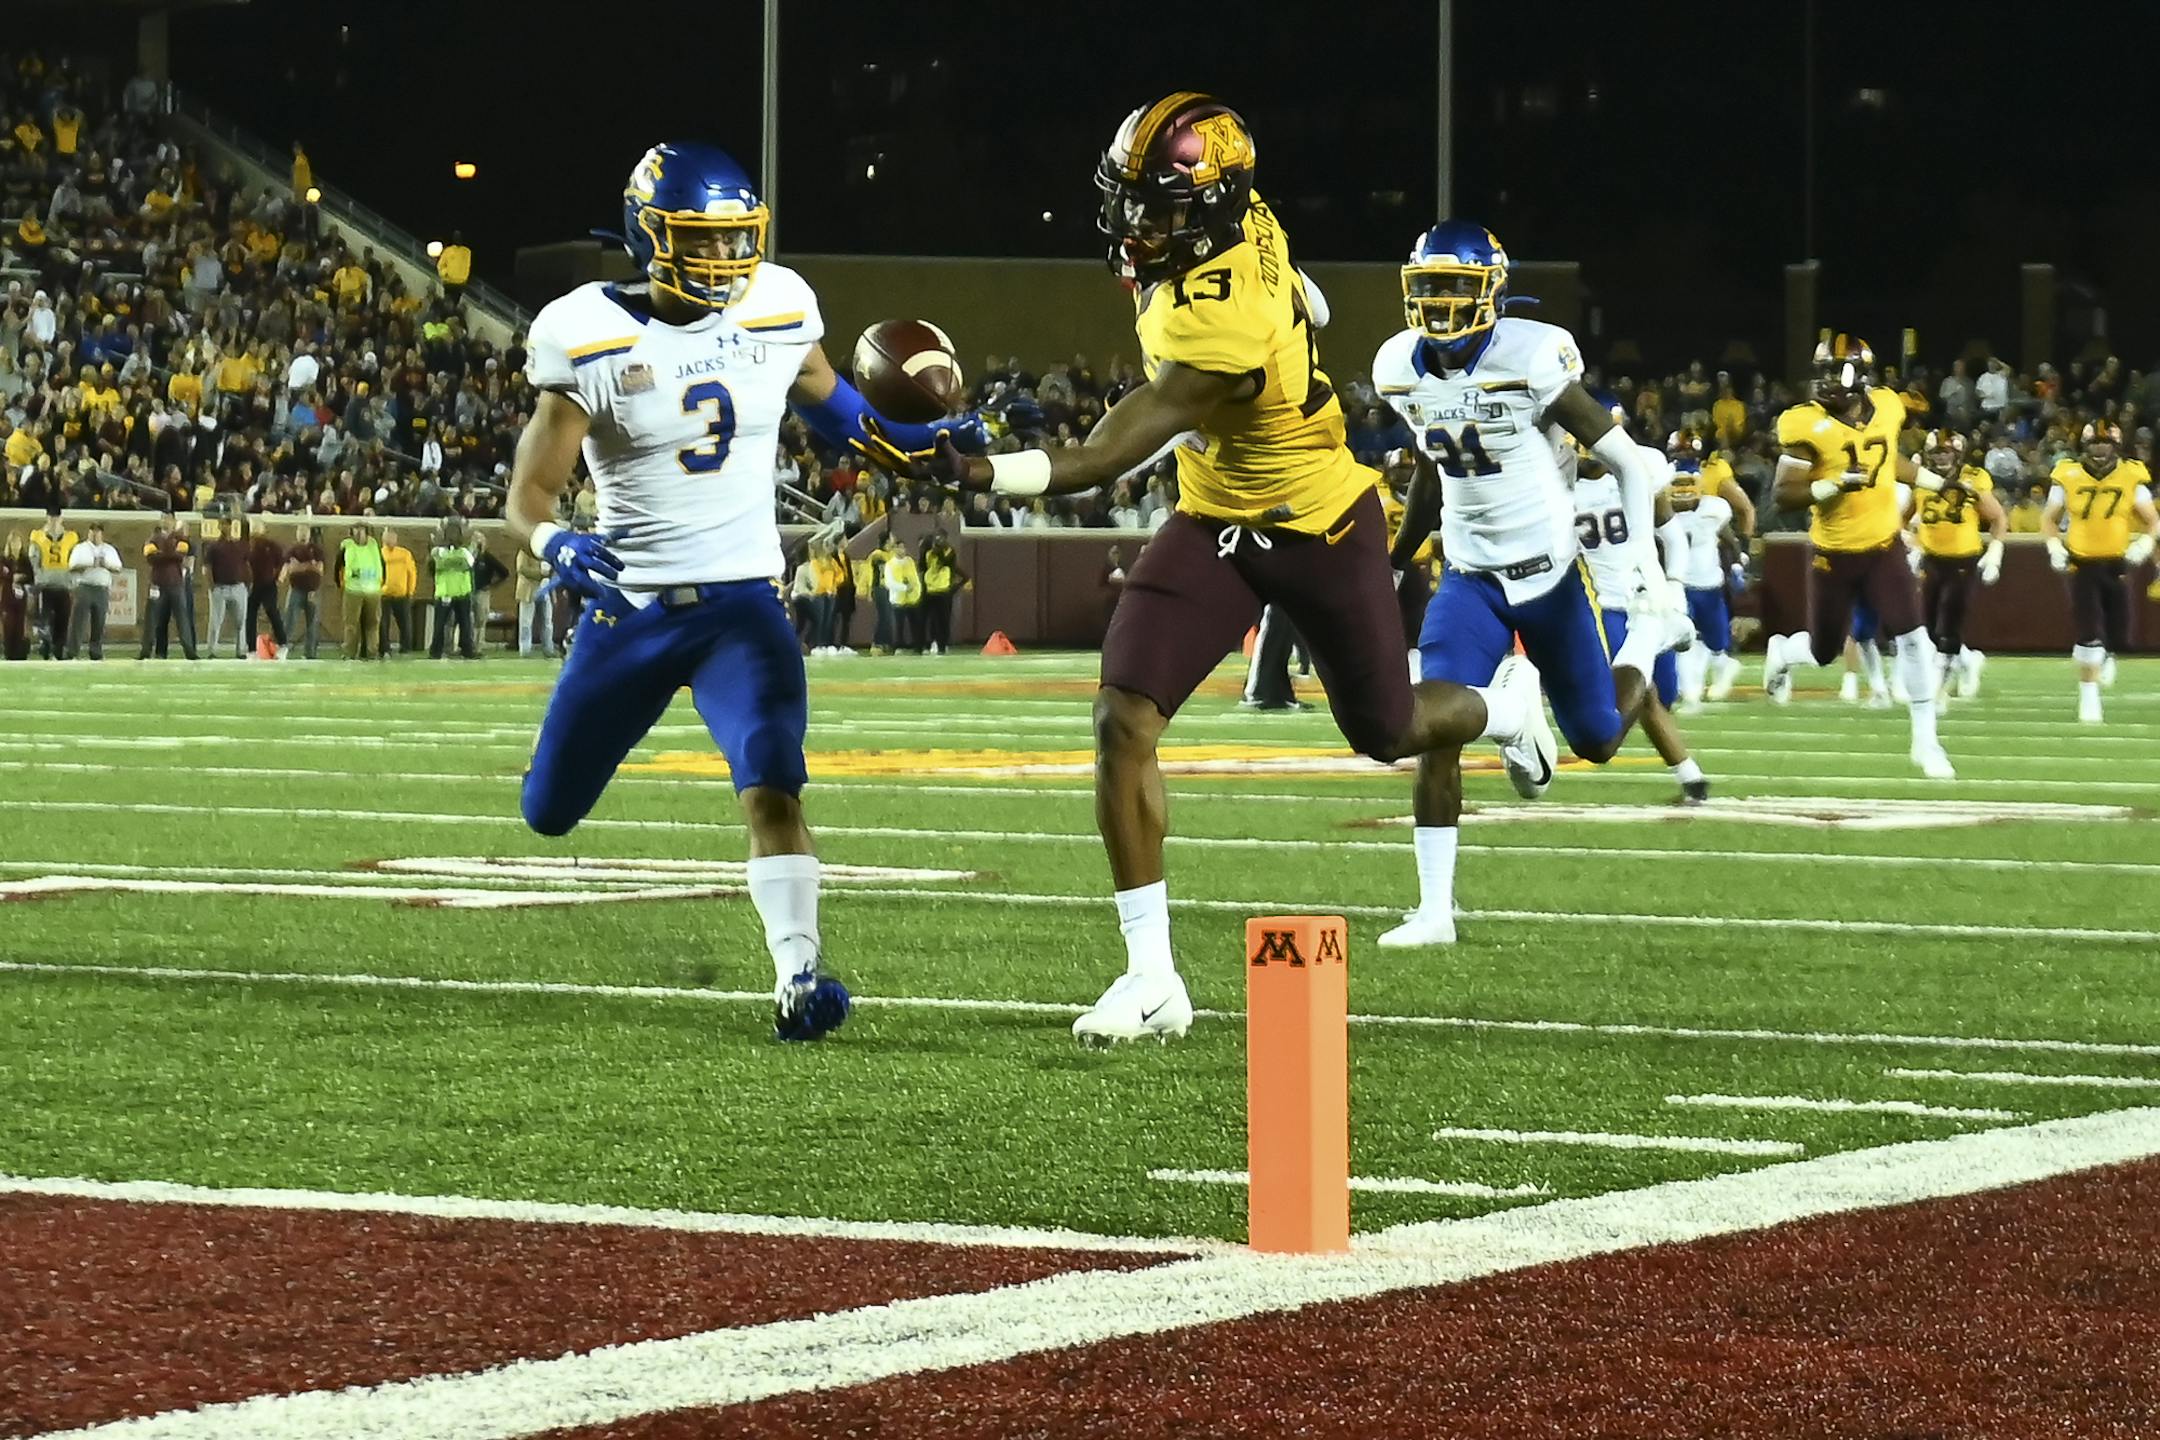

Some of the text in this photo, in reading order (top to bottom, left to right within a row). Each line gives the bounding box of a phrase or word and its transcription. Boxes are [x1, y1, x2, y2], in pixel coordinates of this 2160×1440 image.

[1191, 112, 1255, 186] M
[1172, 267, 1231, 309] 13
[675, 356, 726, 379] JACKS
[677, 378, 736, 475] 3
[1432, 408, 1466, 420] JACKS
[1841, 435, 1888, 488] 17
[2076, 486, 2122, 520] 77
[1251, 930, 1306, 967] M
[1315, 929, 1342, 965] M
